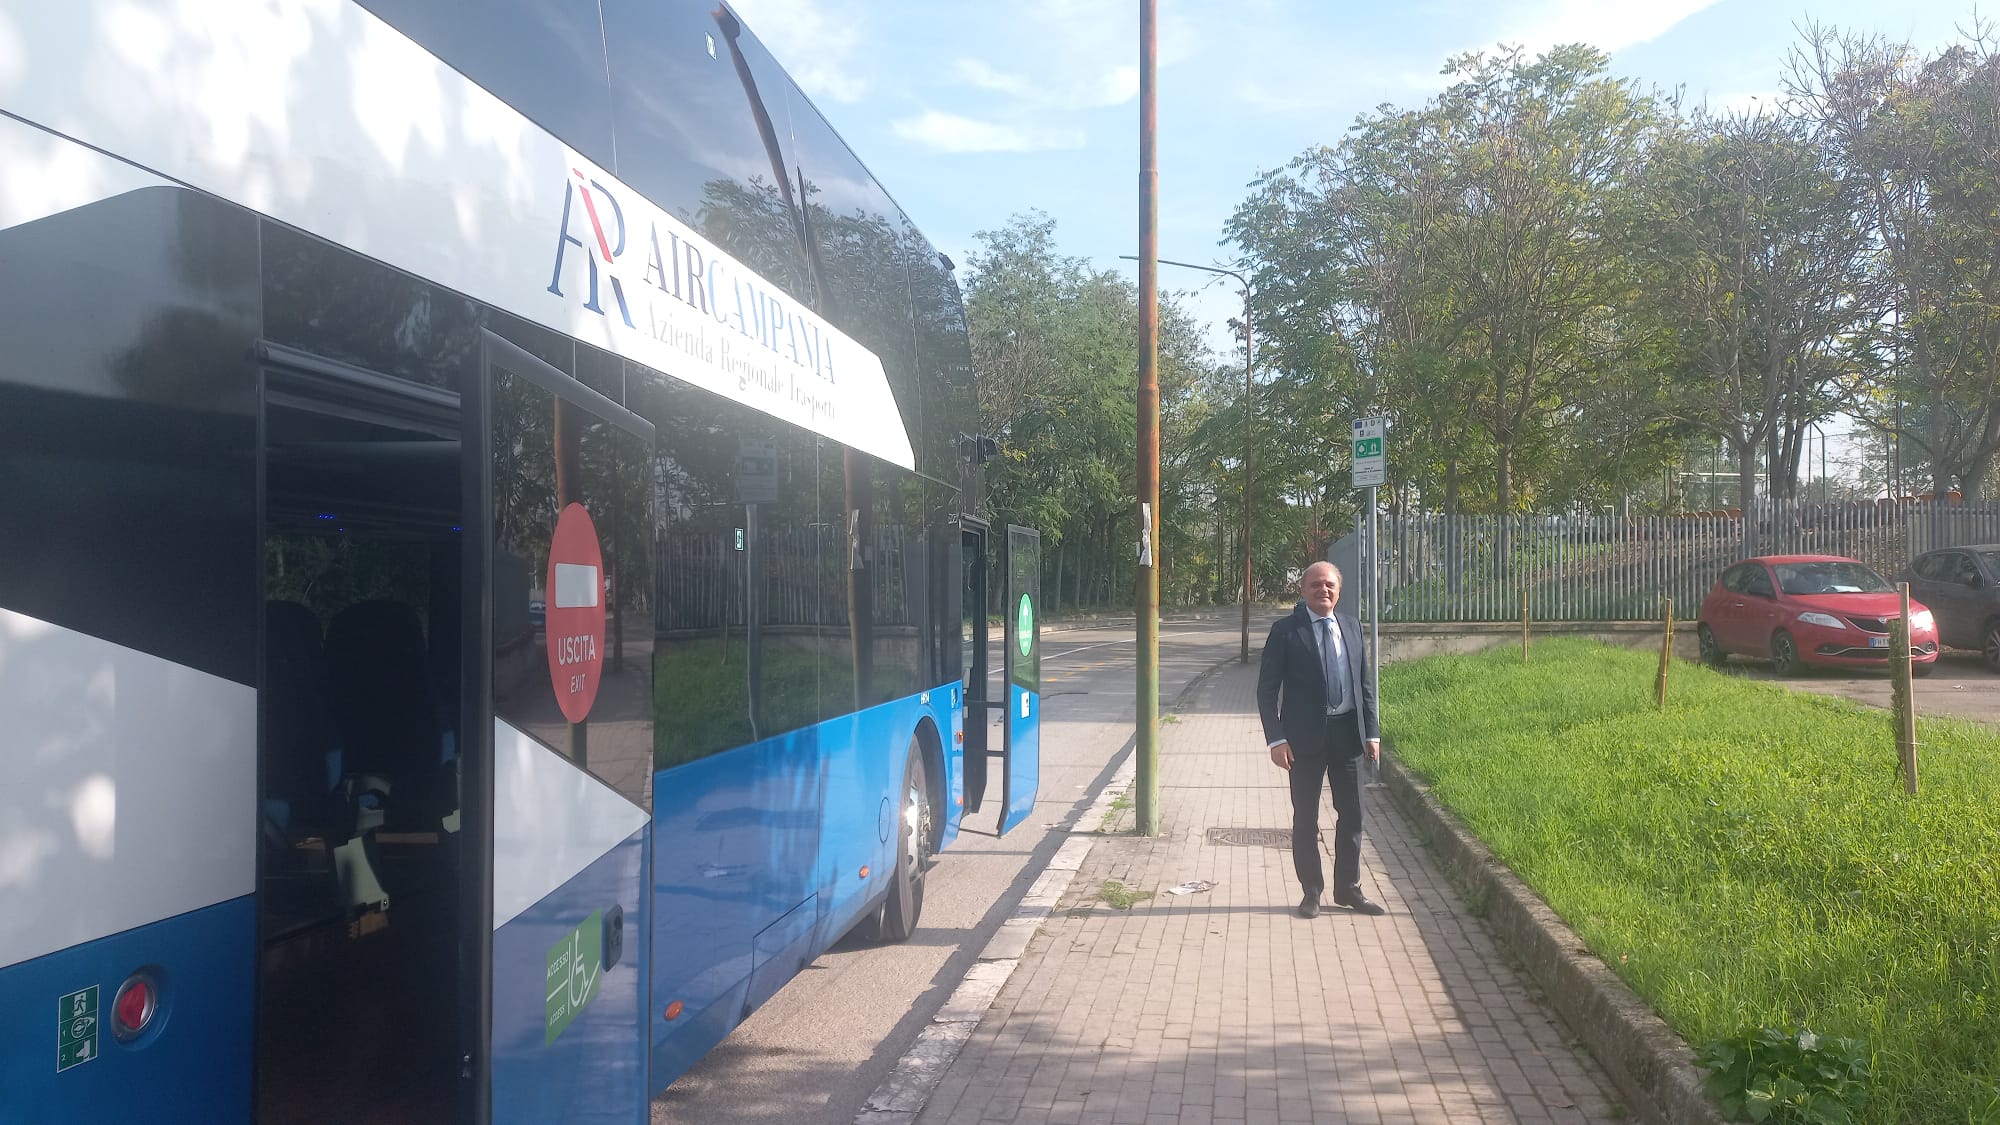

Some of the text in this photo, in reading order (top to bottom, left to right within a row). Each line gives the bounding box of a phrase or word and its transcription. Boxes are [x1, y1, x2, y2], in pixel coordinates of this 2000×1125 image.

[643, 220, 836, 385] AIRCAMPANIA
[644, 302, 714, 365] Azienda
[720, 336, 784, 393] Regionale
[558, 635, 596, 665] USCITA
[570, 673, 585, 693] EXIT
[547, 952, 568, 979] ACCESSO
